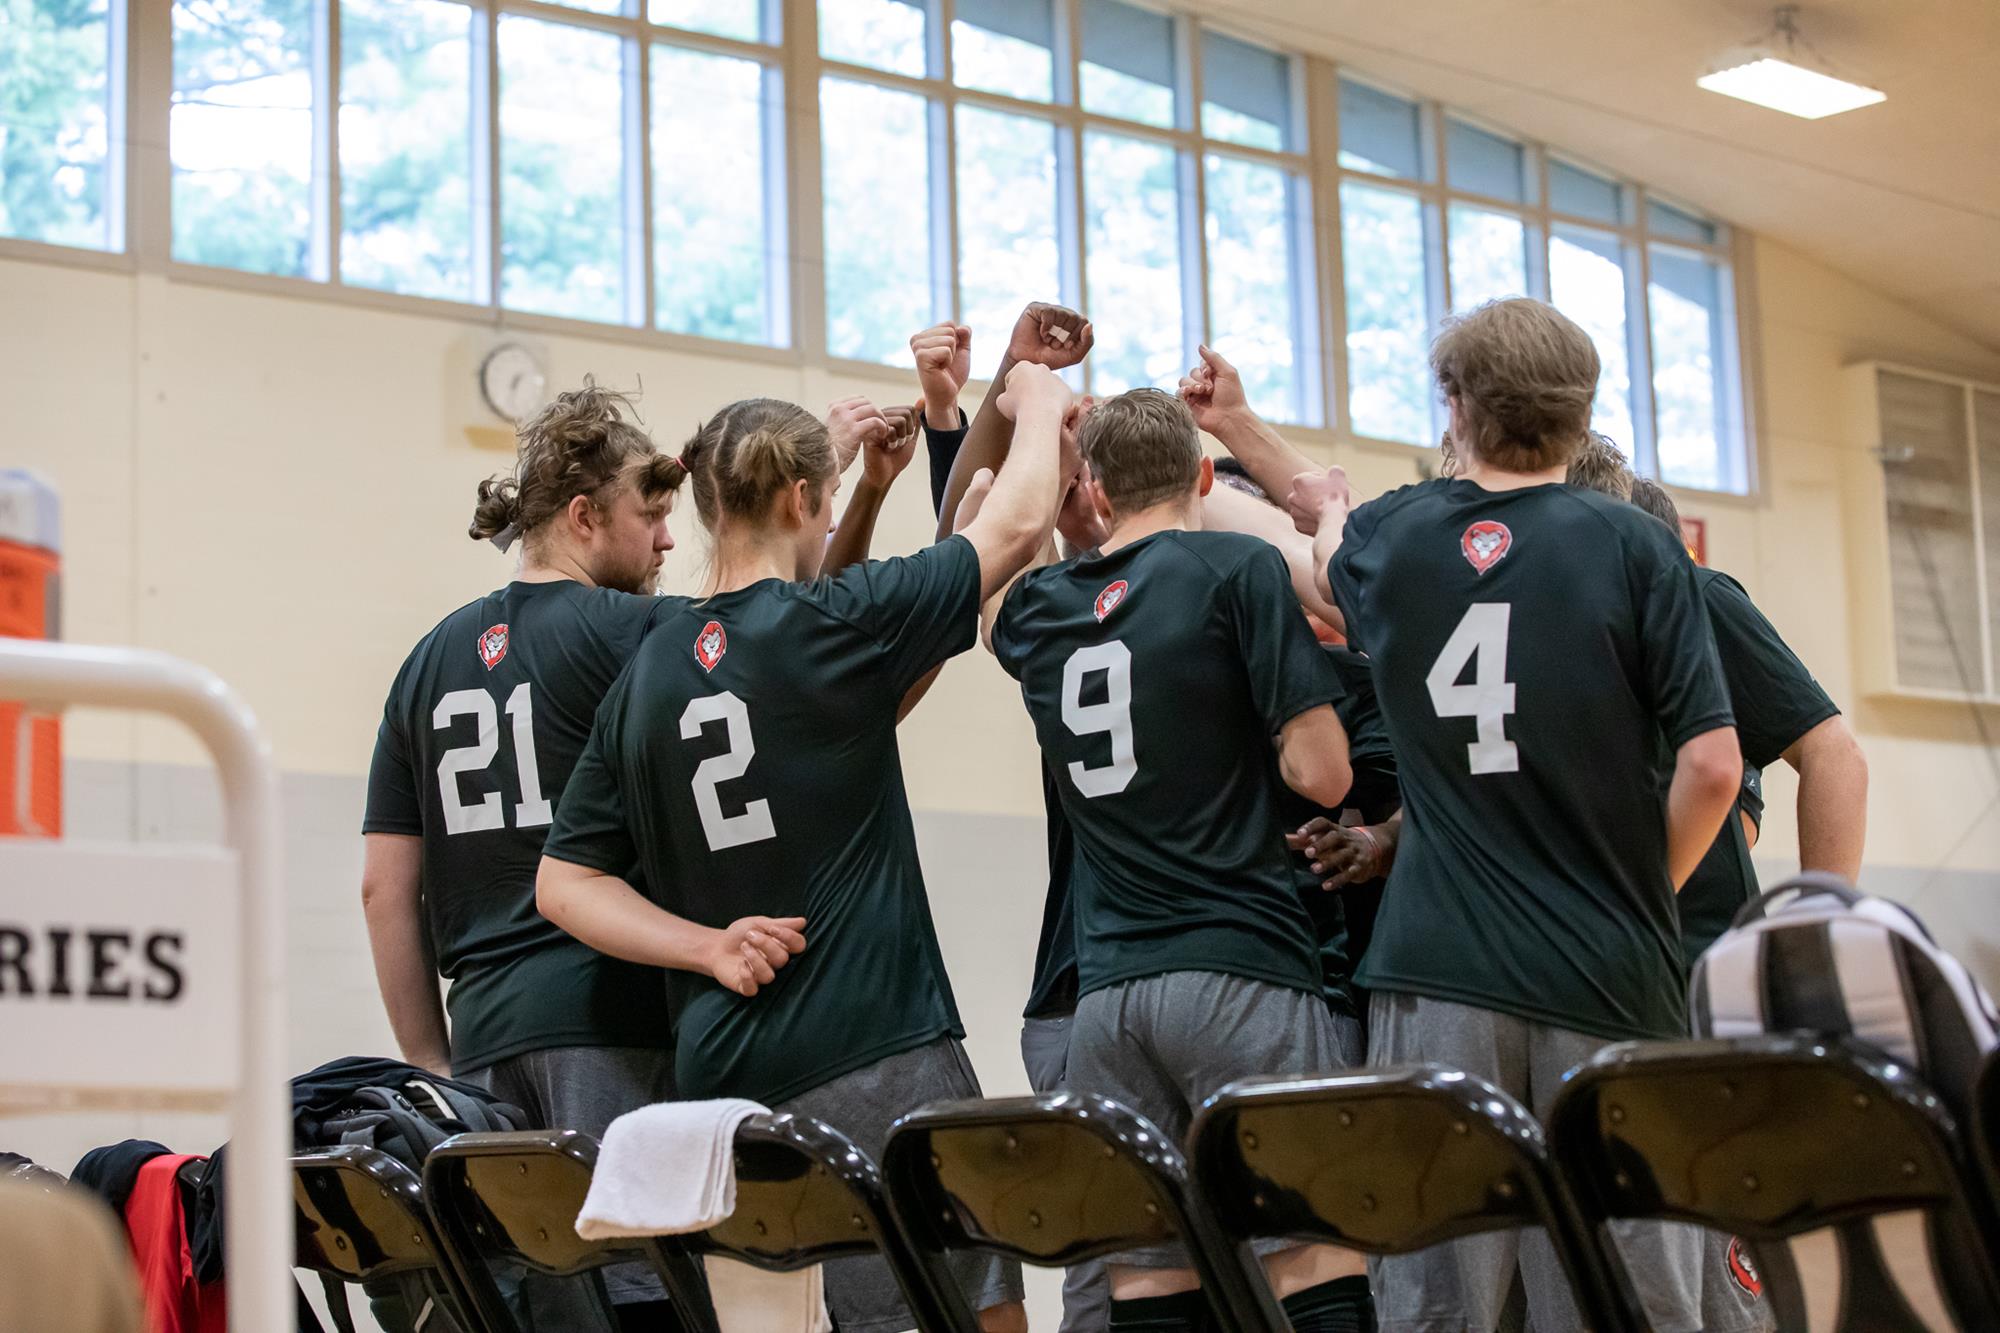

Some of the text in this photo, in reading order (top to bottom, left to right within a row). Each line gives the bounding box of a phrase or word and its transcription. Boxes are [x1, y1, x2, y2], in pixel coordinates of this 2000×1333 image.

[432, 682, 554, 836] 21
[1061, 639, 1138, 799] 9
[1425, 602, 1519, 775] 4
[679, 690, 777, 852] 2
[0, 925, 186, 1004] RIES
